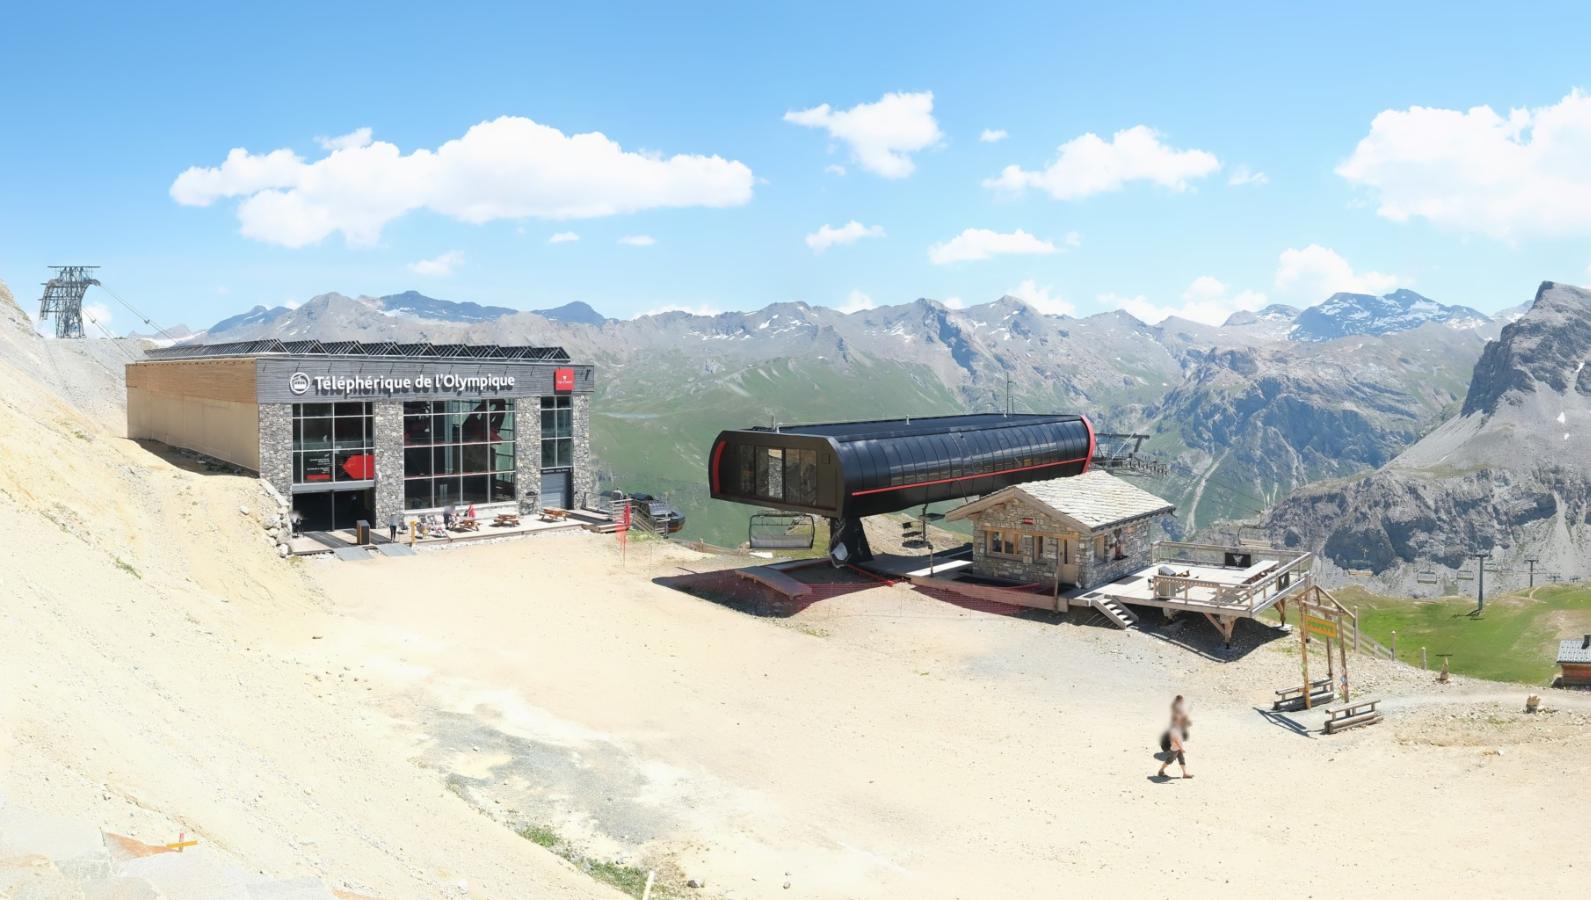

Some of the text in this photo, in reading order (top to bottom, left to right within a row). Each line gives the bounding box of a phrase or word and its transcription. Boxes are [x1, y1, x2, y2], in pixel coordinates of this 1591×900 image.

[314, 374, 515, 393] Téléphérique de l'Olympique
